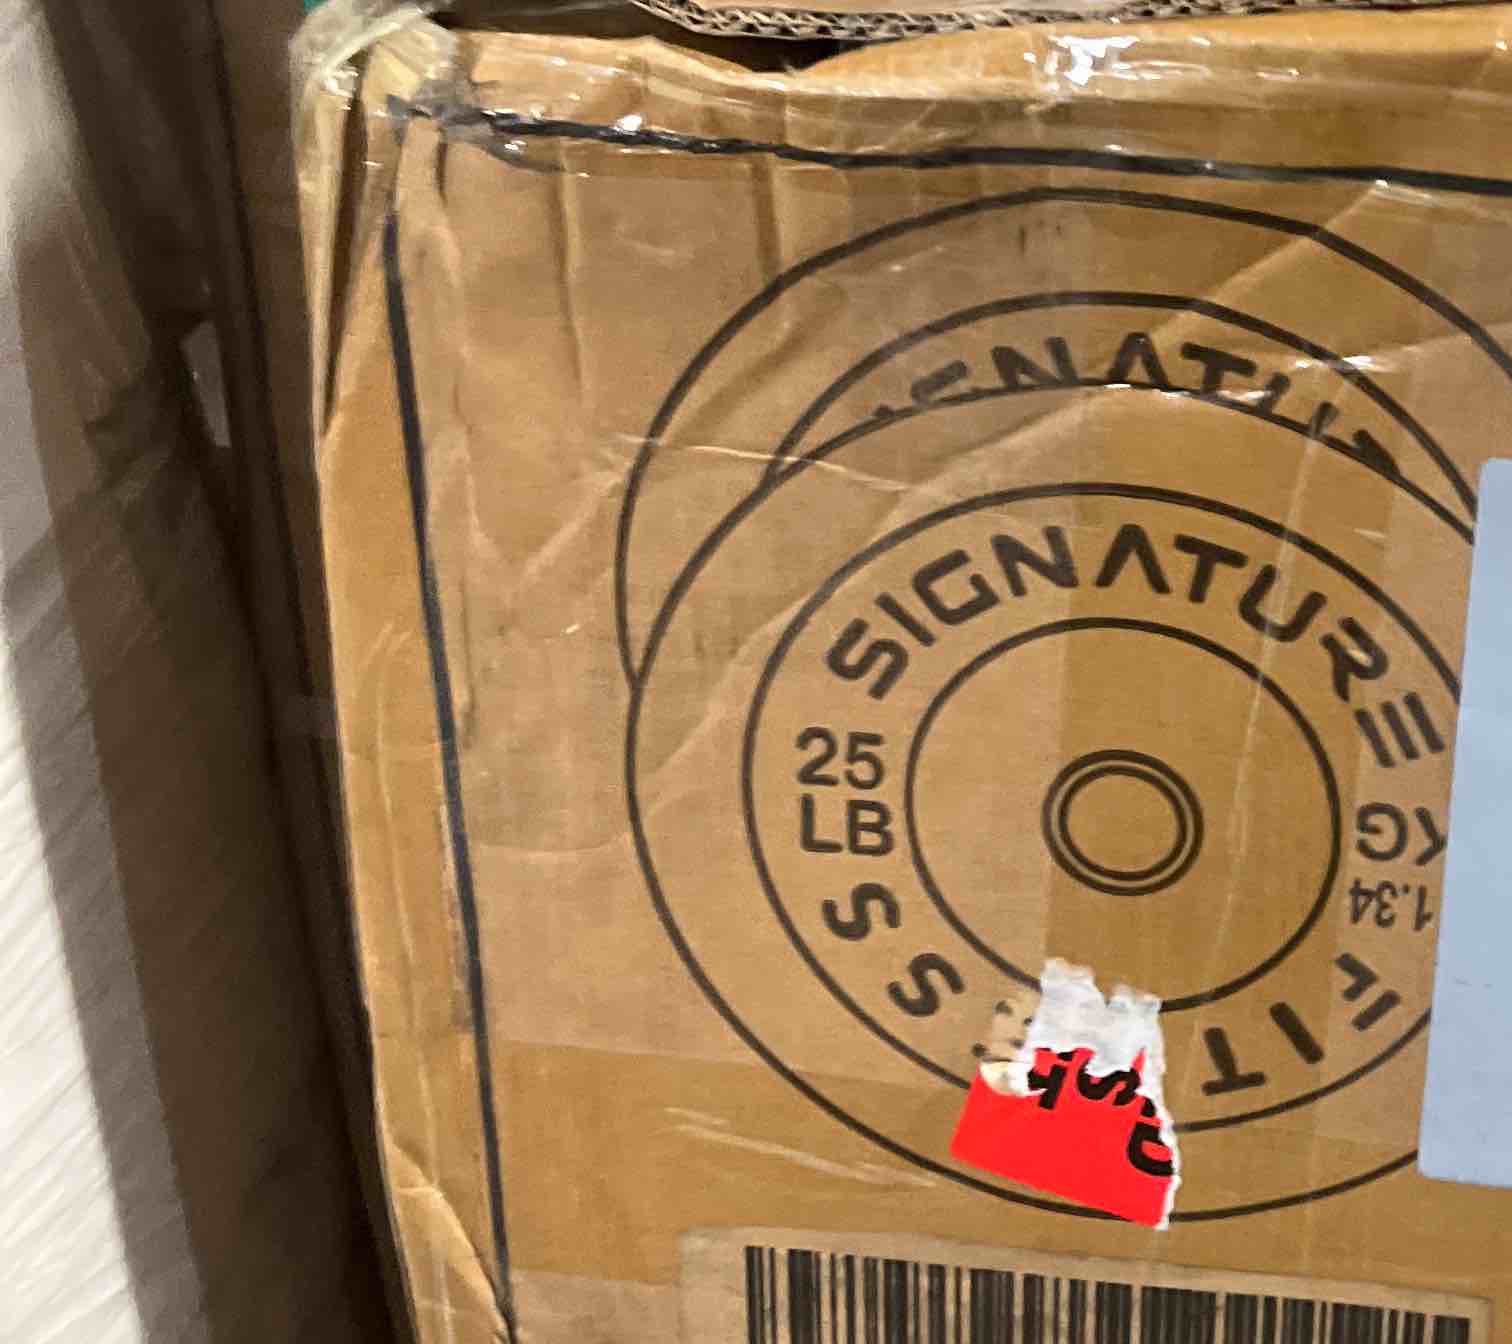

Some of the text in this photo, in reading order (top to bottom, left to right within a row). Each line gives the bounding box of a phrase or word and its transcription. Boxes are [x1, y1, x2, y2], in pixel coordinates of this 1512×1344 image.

[824, 522, 1447, 769] SIGNATURE
[796, 726, 887, 791] 25
[800, 794, 895, 856] LB
